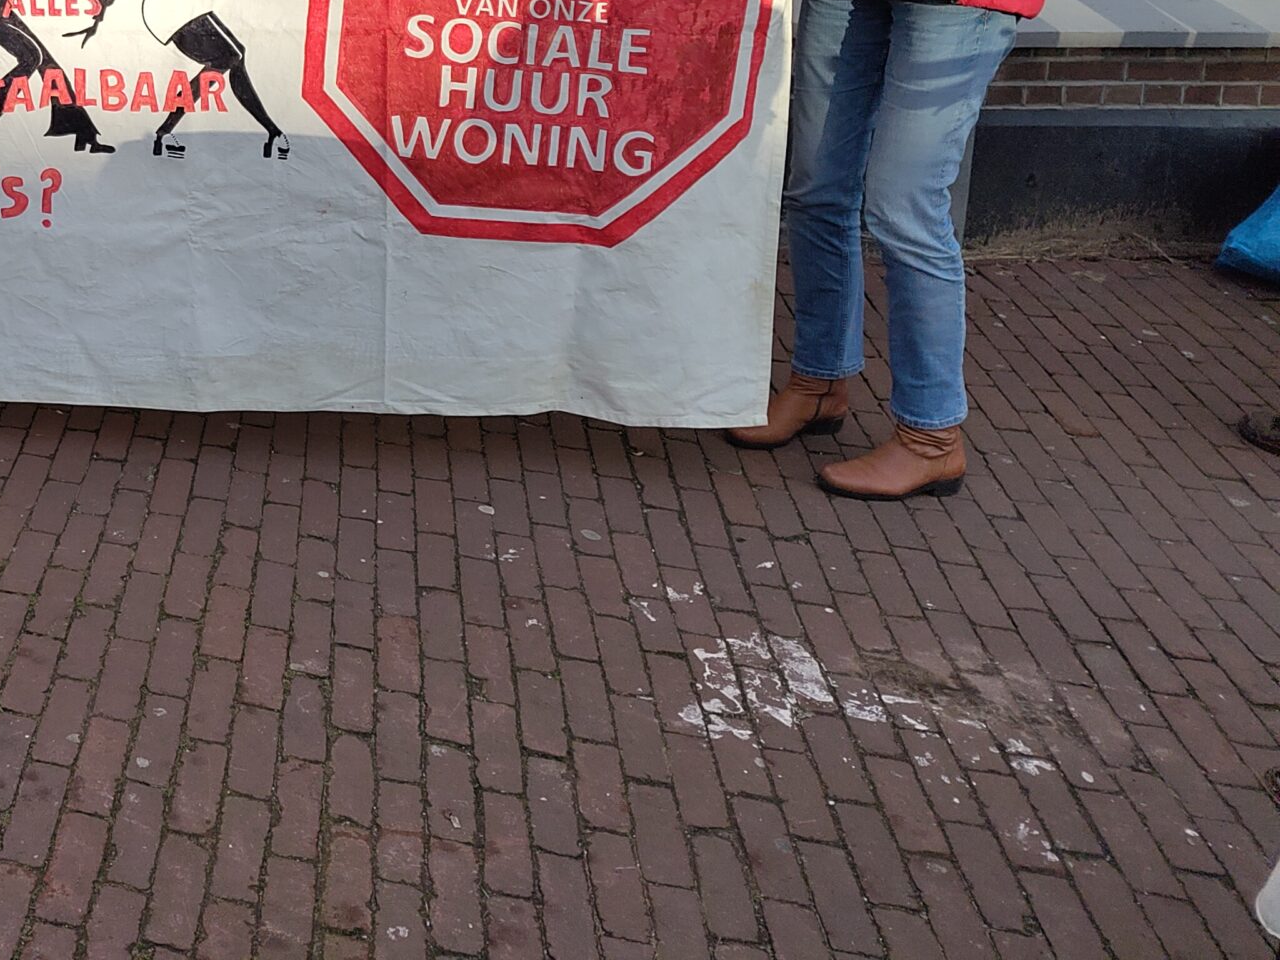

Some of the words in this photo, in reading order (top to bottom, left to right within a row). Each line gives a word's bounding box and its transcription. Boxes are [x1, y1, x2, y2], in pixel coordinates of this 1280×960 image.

[404, 14, 651, 75] SOCIALE
[439, 65, 612, 118] HUUR
[391, 115, 655, 177] WONING
